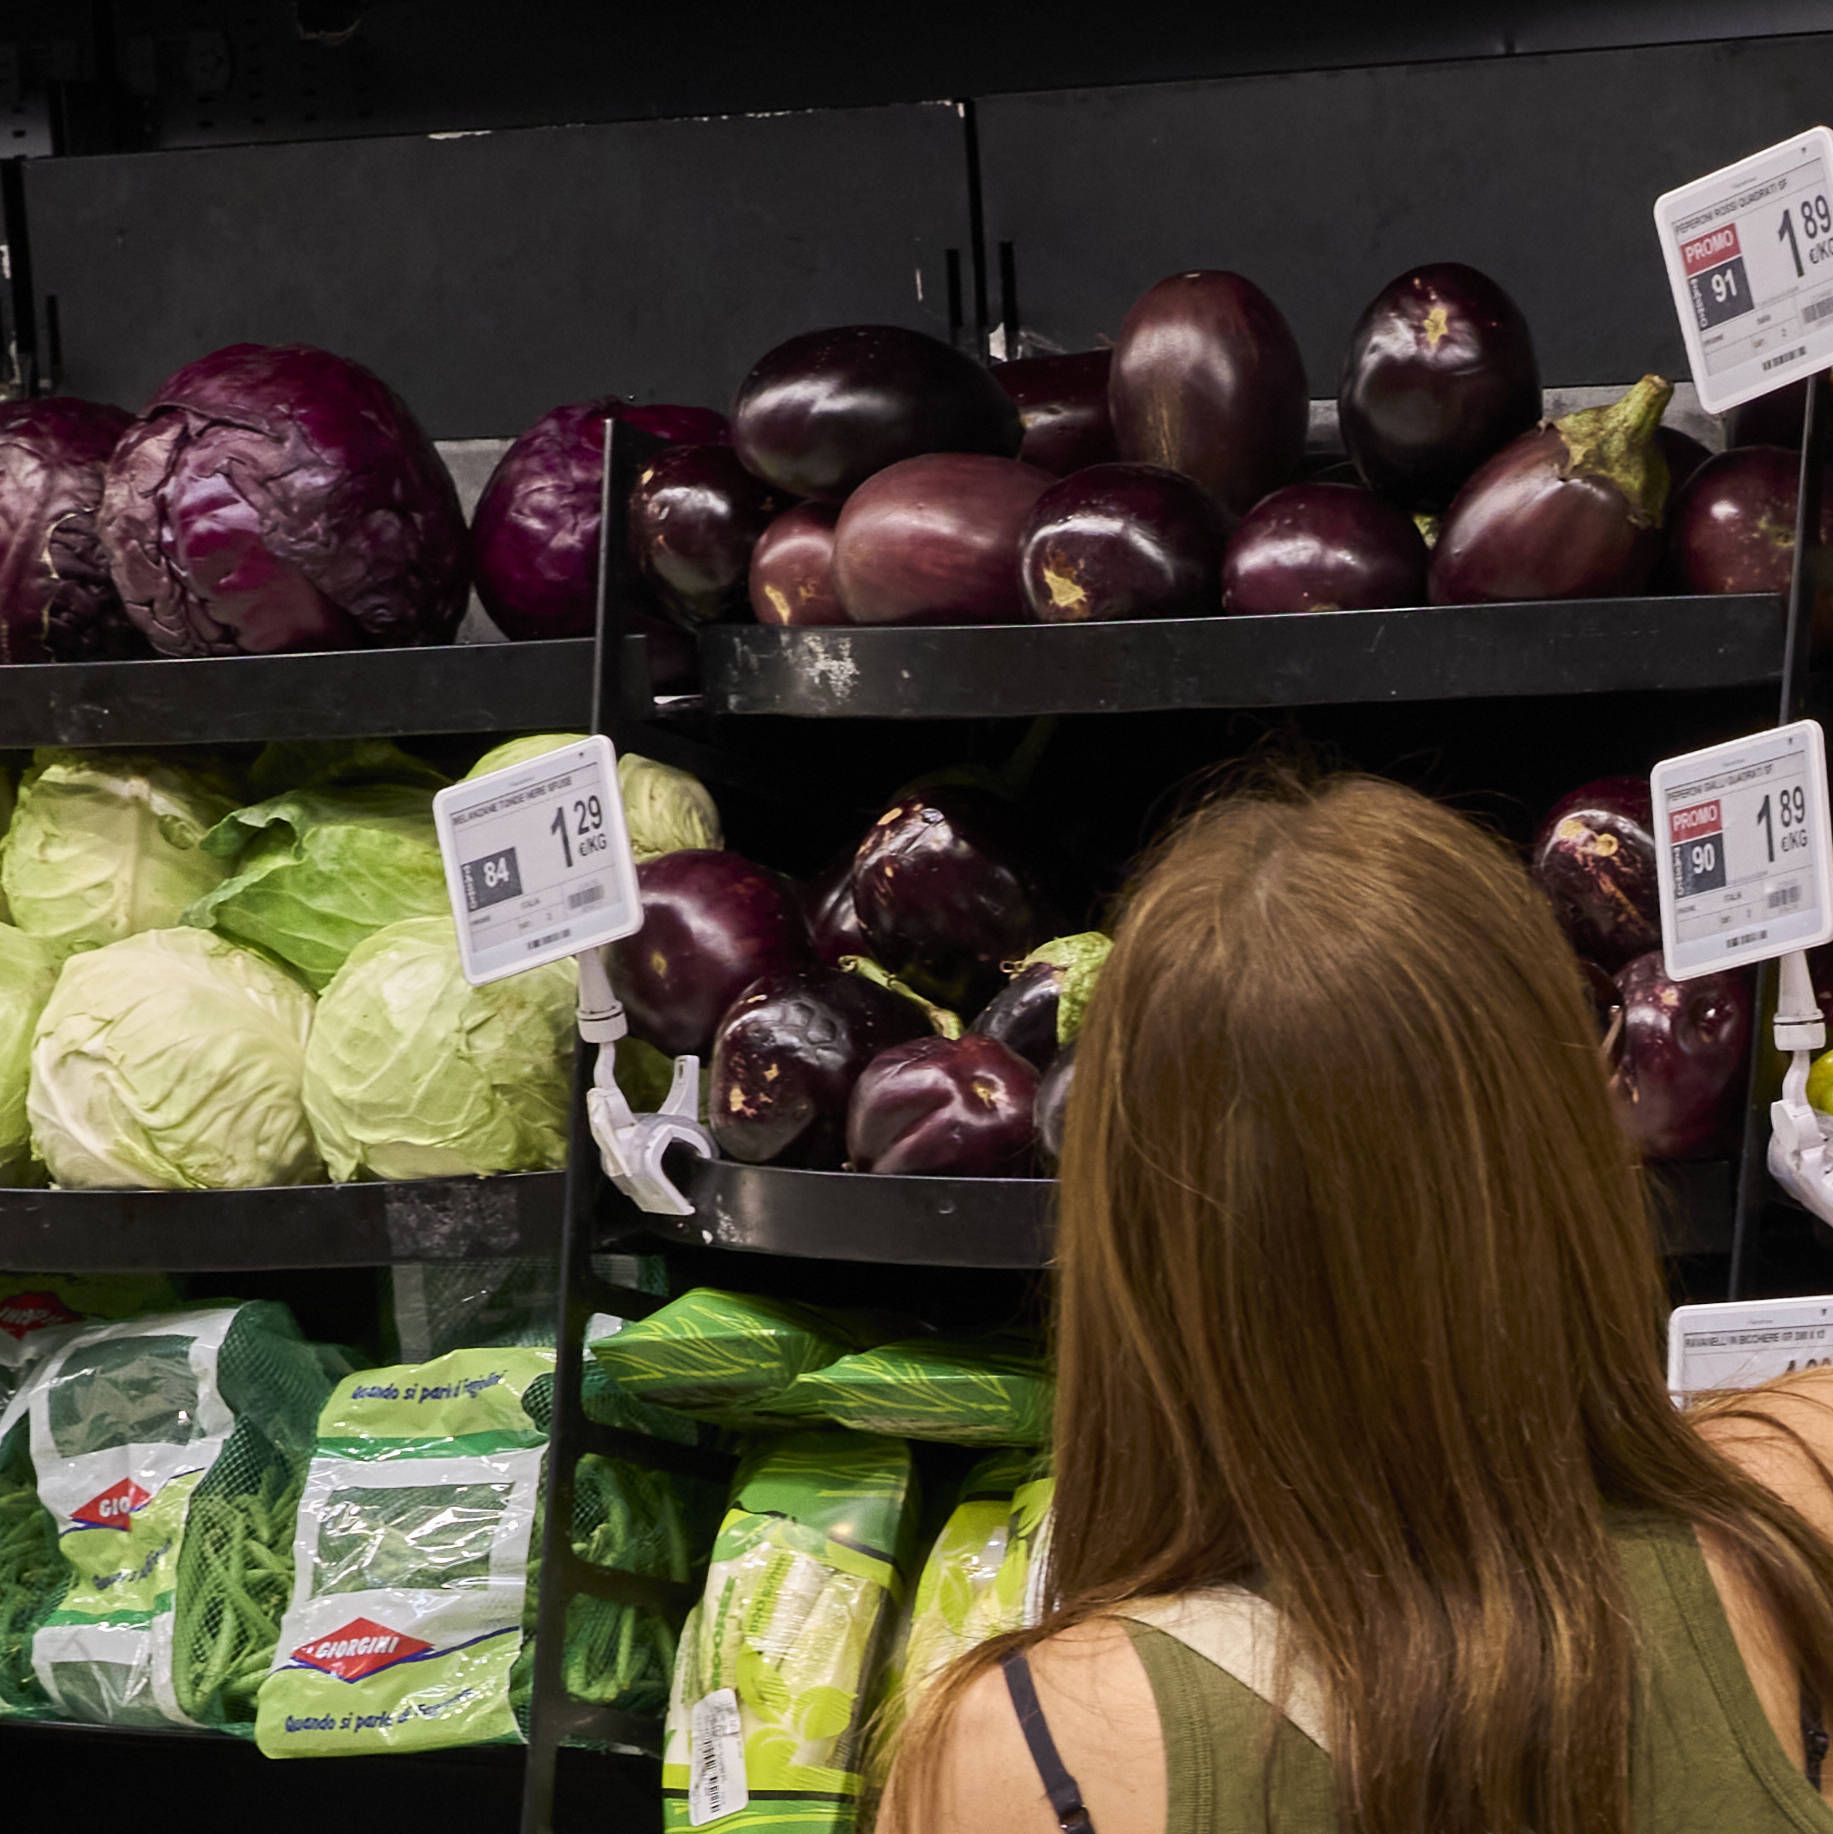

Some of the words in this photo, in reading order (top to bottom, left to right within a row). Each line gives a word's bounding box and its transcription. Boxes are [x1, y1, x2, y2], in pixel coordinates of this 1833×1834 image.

[1685, 229, 1735, 264] PROMO
[1778, 208, 1805, 278] 1
[1801, 195, 1832, 239] 89
[1711, 268, 1737, 303] 91
[551, 806, 573, 868] 1
[574, 795, 603, 835] 29
[1673, 804, 1718, 832] PROMO
[1756, 793, 1775, 863] 1
[1780, 785, 1805, 828] 89
[579, 833, 607, 857] €/KG
[1780, 829, 1809, 853] €/KG
[483, 856, 510, 888] 84
[1692, 842, 1715, 875] 90
[315, 1635, 401, 1660] GIORGINI
